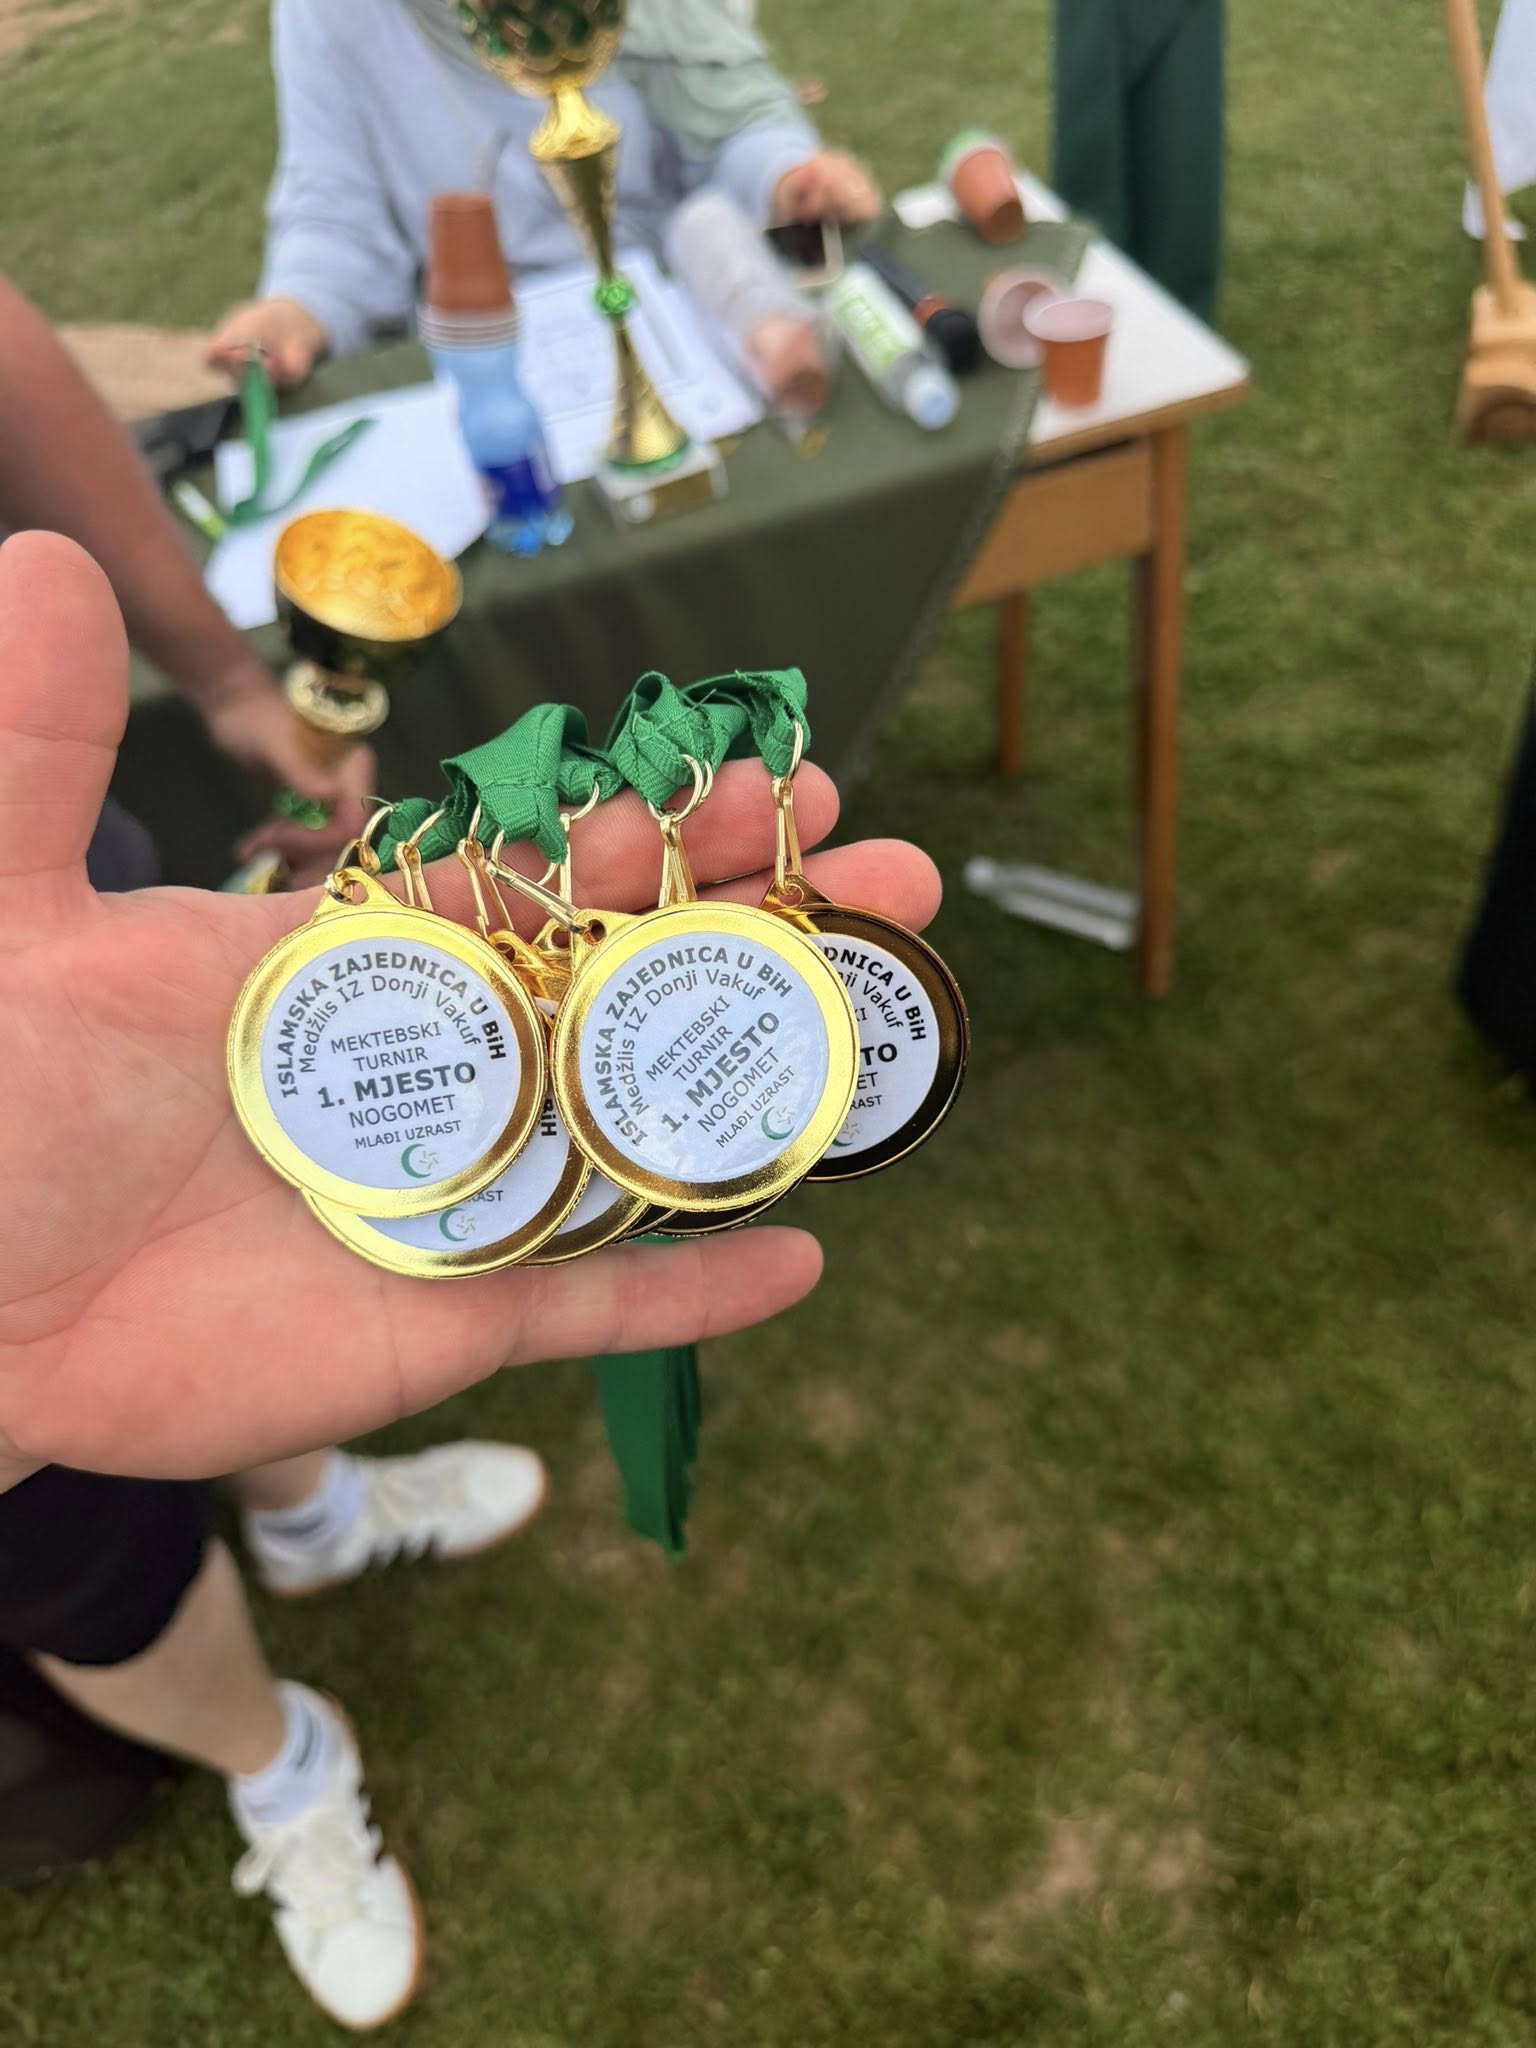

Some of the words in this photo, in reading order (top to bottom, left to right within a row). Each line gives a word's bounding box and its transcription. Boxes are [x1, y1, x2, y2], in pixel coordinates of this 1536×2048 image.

[605, 946, 728, 1021] ZAJEDNICA
[705, 968, 766, 1001] Vakuf
[736, 952, 754, 970] U
[756, 963, 793, 998] BiH
[644, 969, 698, 1007] Donji
[823, 946, 895, 986] DNICA
[894, 985, 912, 1002] U
[905, 1005, 927, 1041] BiH
[863, 980, 904, 1029] Vakuf
[277, 978, 329, 1098] ISLAMSKA
[328, 952, 470, 998] ZAJEDNICA
[469, 997, 488, 1015] U
[481, 1020, 507, 1060] BiH
[299, 1000, 338, 1073] Medžlis
[337, 980, 365, 1003] IZ
[371, 975, 430, 999] Donji
[436, 991, 481, 1046] Vakuf
[330, 1021, 442, 1054] MEKTEBSKI
[624, 1006, 649, 1033] IZ
[645, 995, 731, 1082] MEKTEBSKI
[353, 1046, 429, 1072] TURNIR
[616, 1038, 650, 1116] Medžlis
[660, 1112, 690, 1134] 1.
[685, 1012, 780, 1107] MJESTO
[672, 1025, 733, 1082] TURNIR
[317, 1087, 345, 1109] 1.
[353, 1061, 476, 1102] MJESTO
[349, 1094, 456, 1129] NOGOMET
[594, 1027, 648, 1147] ISLAMSKA
[697, 1046, 780, 1132] NOGOMET
[716, 1111, 754, 1148] MLAĐI
[750, 1065, 795, 1111] UZRAST
[354, 1130, 401, 1150] MLAĐI
[404, 1120, 462, 1141] UZRAST
